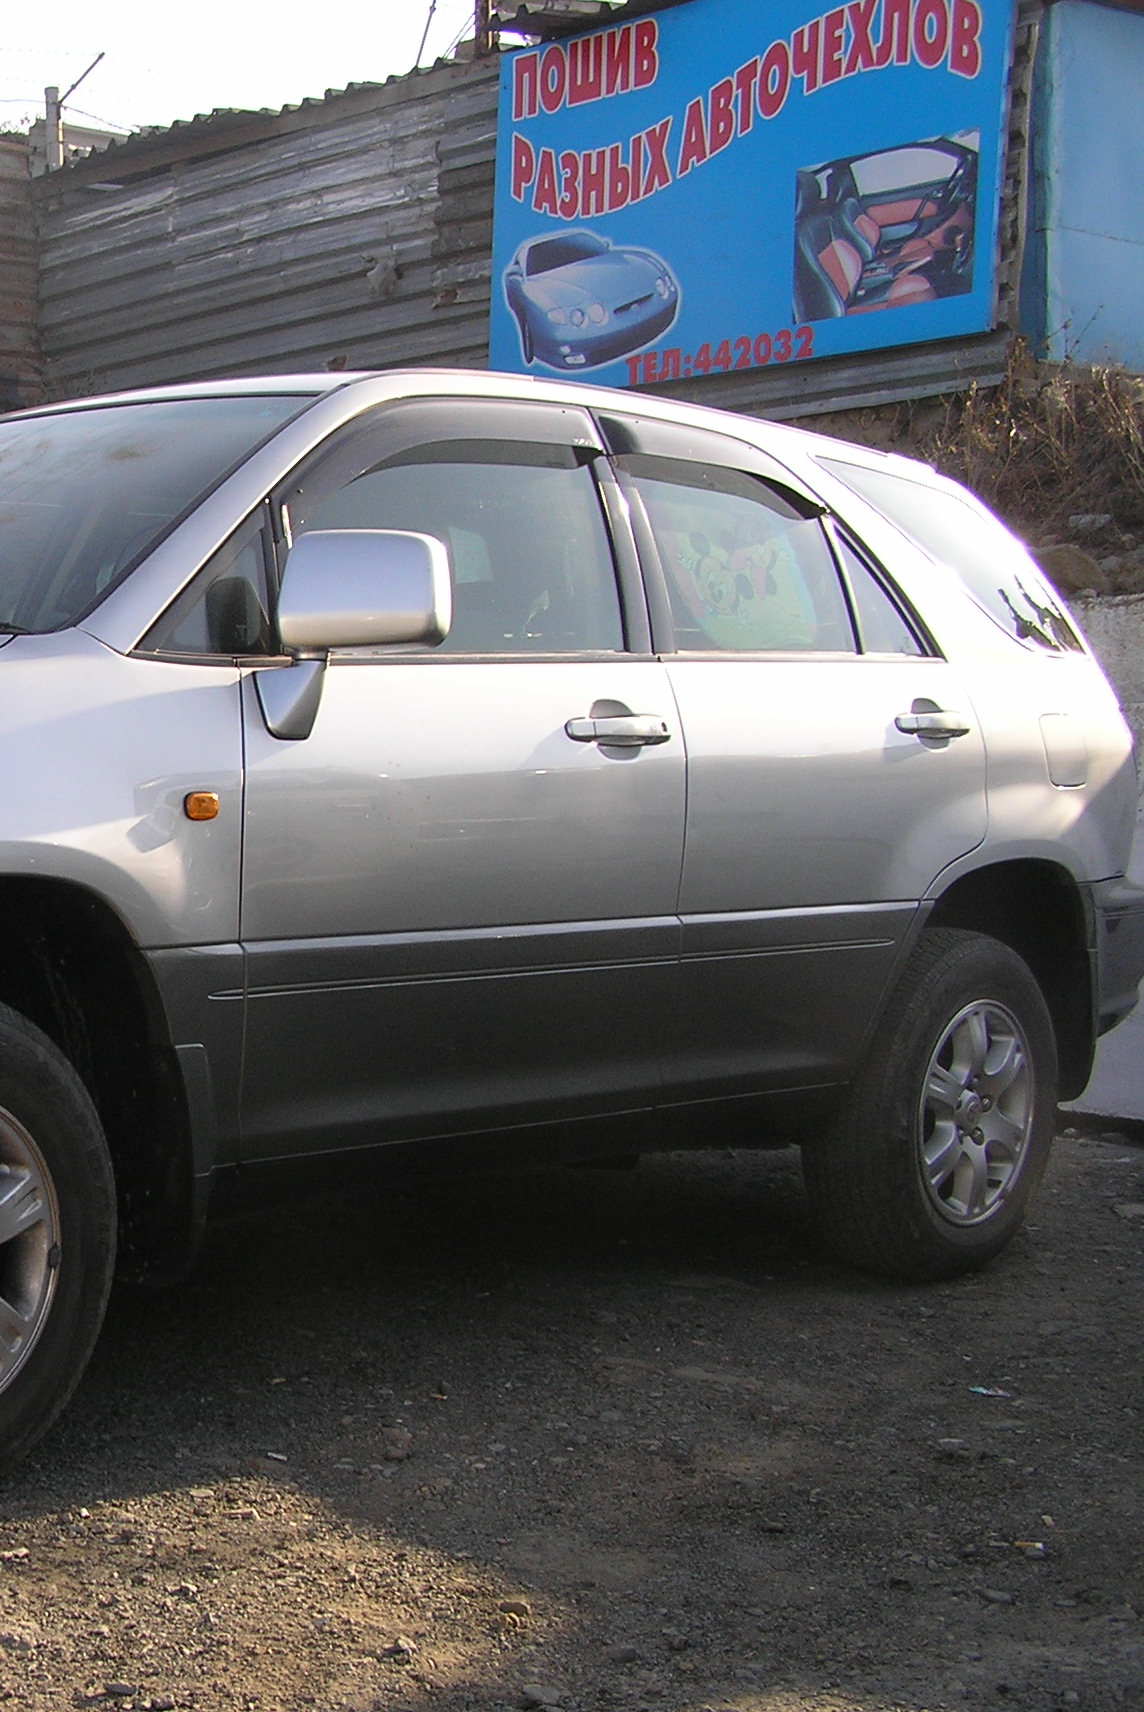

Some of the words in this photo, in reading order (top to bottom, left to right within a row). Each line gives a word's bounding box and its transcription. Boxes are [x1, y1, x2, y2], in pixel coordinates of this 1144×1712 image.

[511, 131, 673, 221] РАЗНЫХ
[677, 0, 982, 178] АВТОЧЕХЛОВ
[512, 18, 659, 121] ПОШИВ
[625, 325, 814, 386] ТЕЛ:442032
